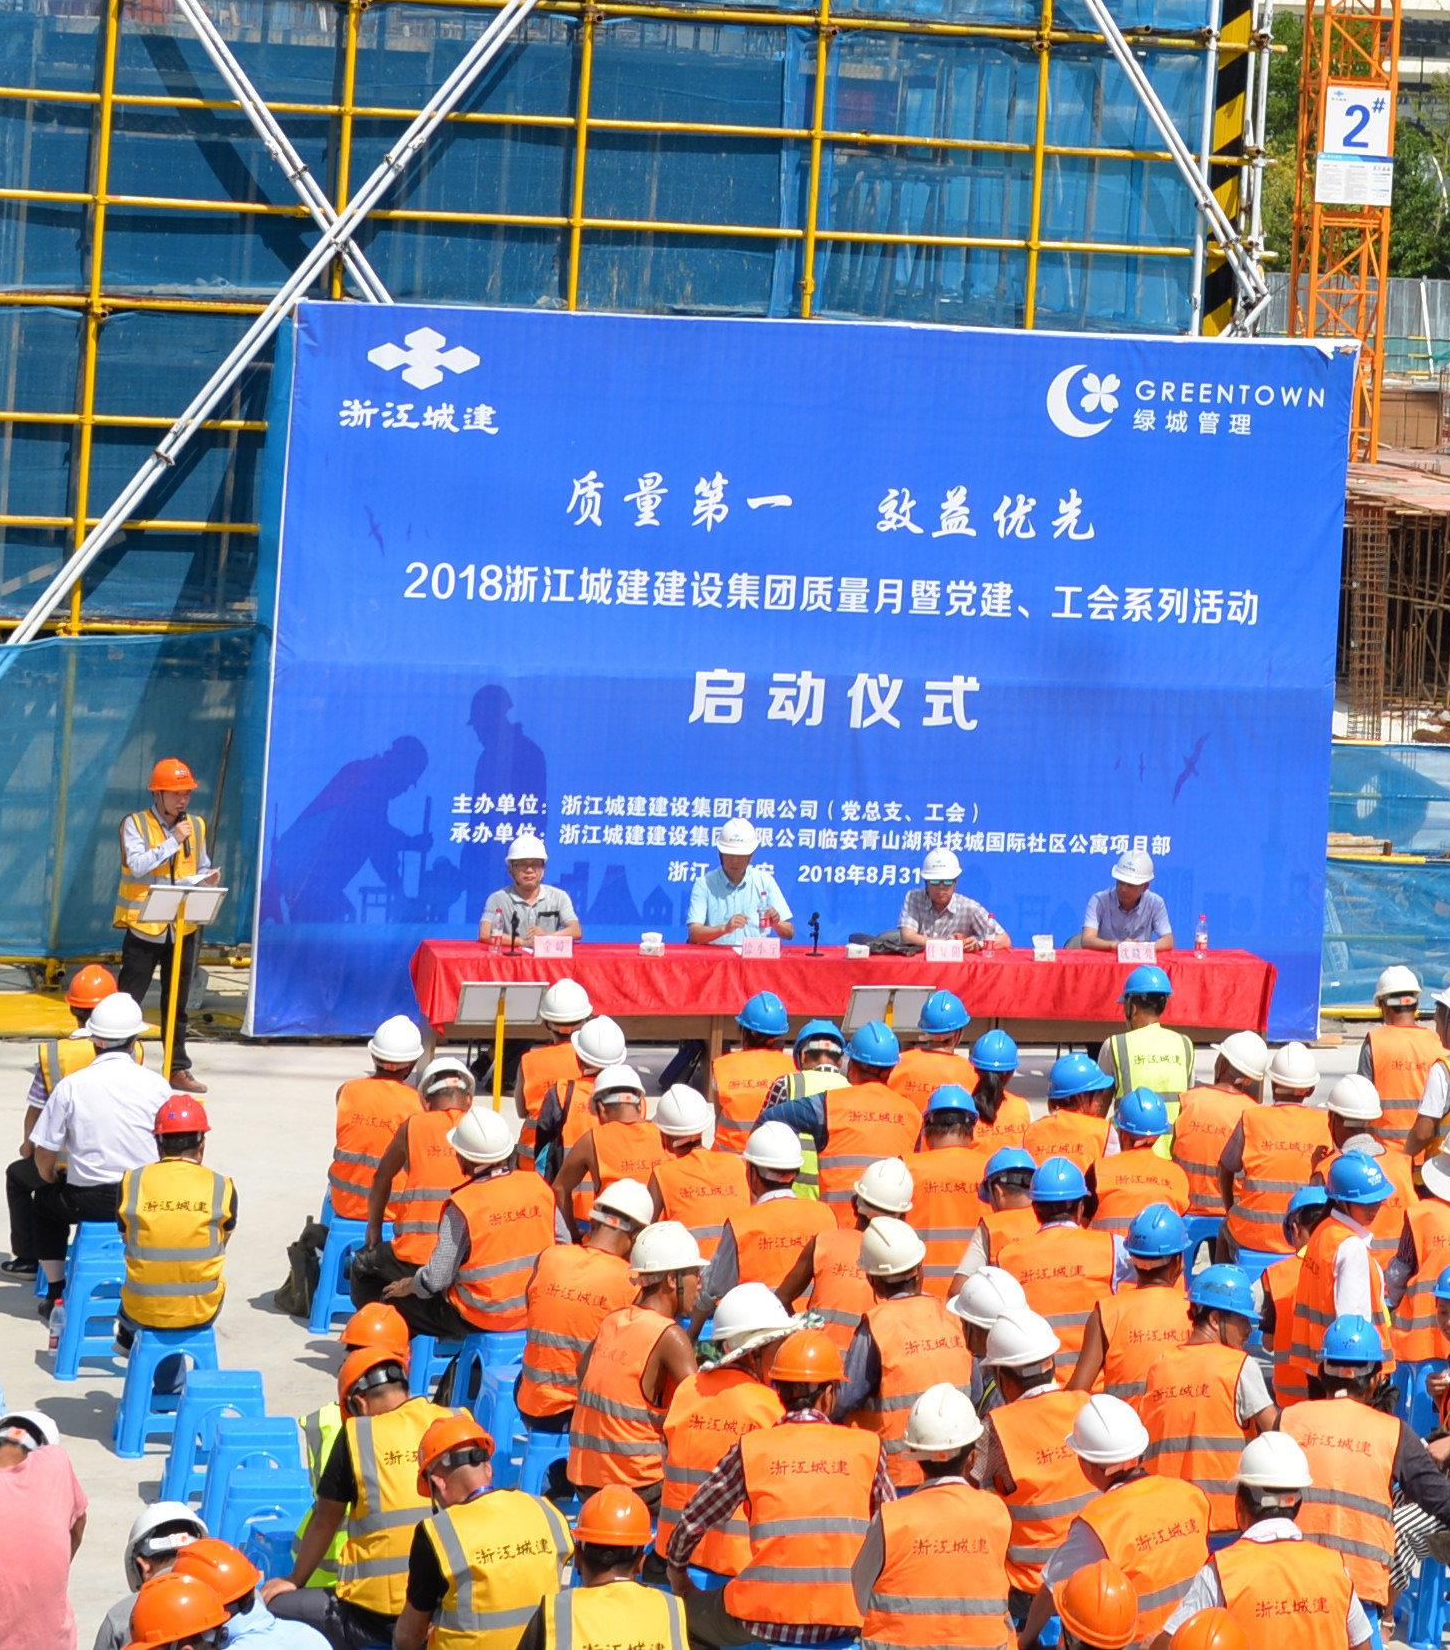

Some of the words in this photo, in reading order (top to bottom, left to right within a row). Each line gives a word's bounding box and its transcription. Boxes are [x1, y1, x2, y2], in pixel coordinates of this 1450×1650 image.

[1342, 97, 1386, 149] 2#
[1135, 379, 1326, 410] GREENTOWN
[339, 399, 499, 435] 浙江城建
[1134, 409, 1252, 436] 绿城管理
[566, 470, 793, 532] 质量第一
[876, 485, 1096, 541] 效益优先
[404, 561, 1259, 627] 2018浙江城建建设集团质量月暨党建、工会系列活动
[687, 668, 982, 733] 启动仪式
[797, 864, 921, 886] 2018年8月31
[1134, 1054, 1182, 1066] 浙江城建
[1391, 1060, 1431, 1071] 浙江城
[728, 1079, 773, 1090] 浙江城
[849, 1110, 905, 1126] 浙江城建
[143, 1200, 209, 1213] 浙江城建
[832, 1263, 867, 1280] 浙江
[1020, 1265, 1086, 1282] 浙江城建
[1302, 1433, 1372, 1457] 浙江城建
[384, 1451, 420, 1466] 浙江
[1037, 1448, 1076, 1465] 浙江
[770, 1460, 850, 1476] 浙江城建
[1135, 1517, 1200, 1552] 浙江城建
[476, 1538, 552, 1565] 浙江城建
[913, 1539, 989, 1555] 浙江城建
[1256, 1598, 1330, 1618] 浙江城建
